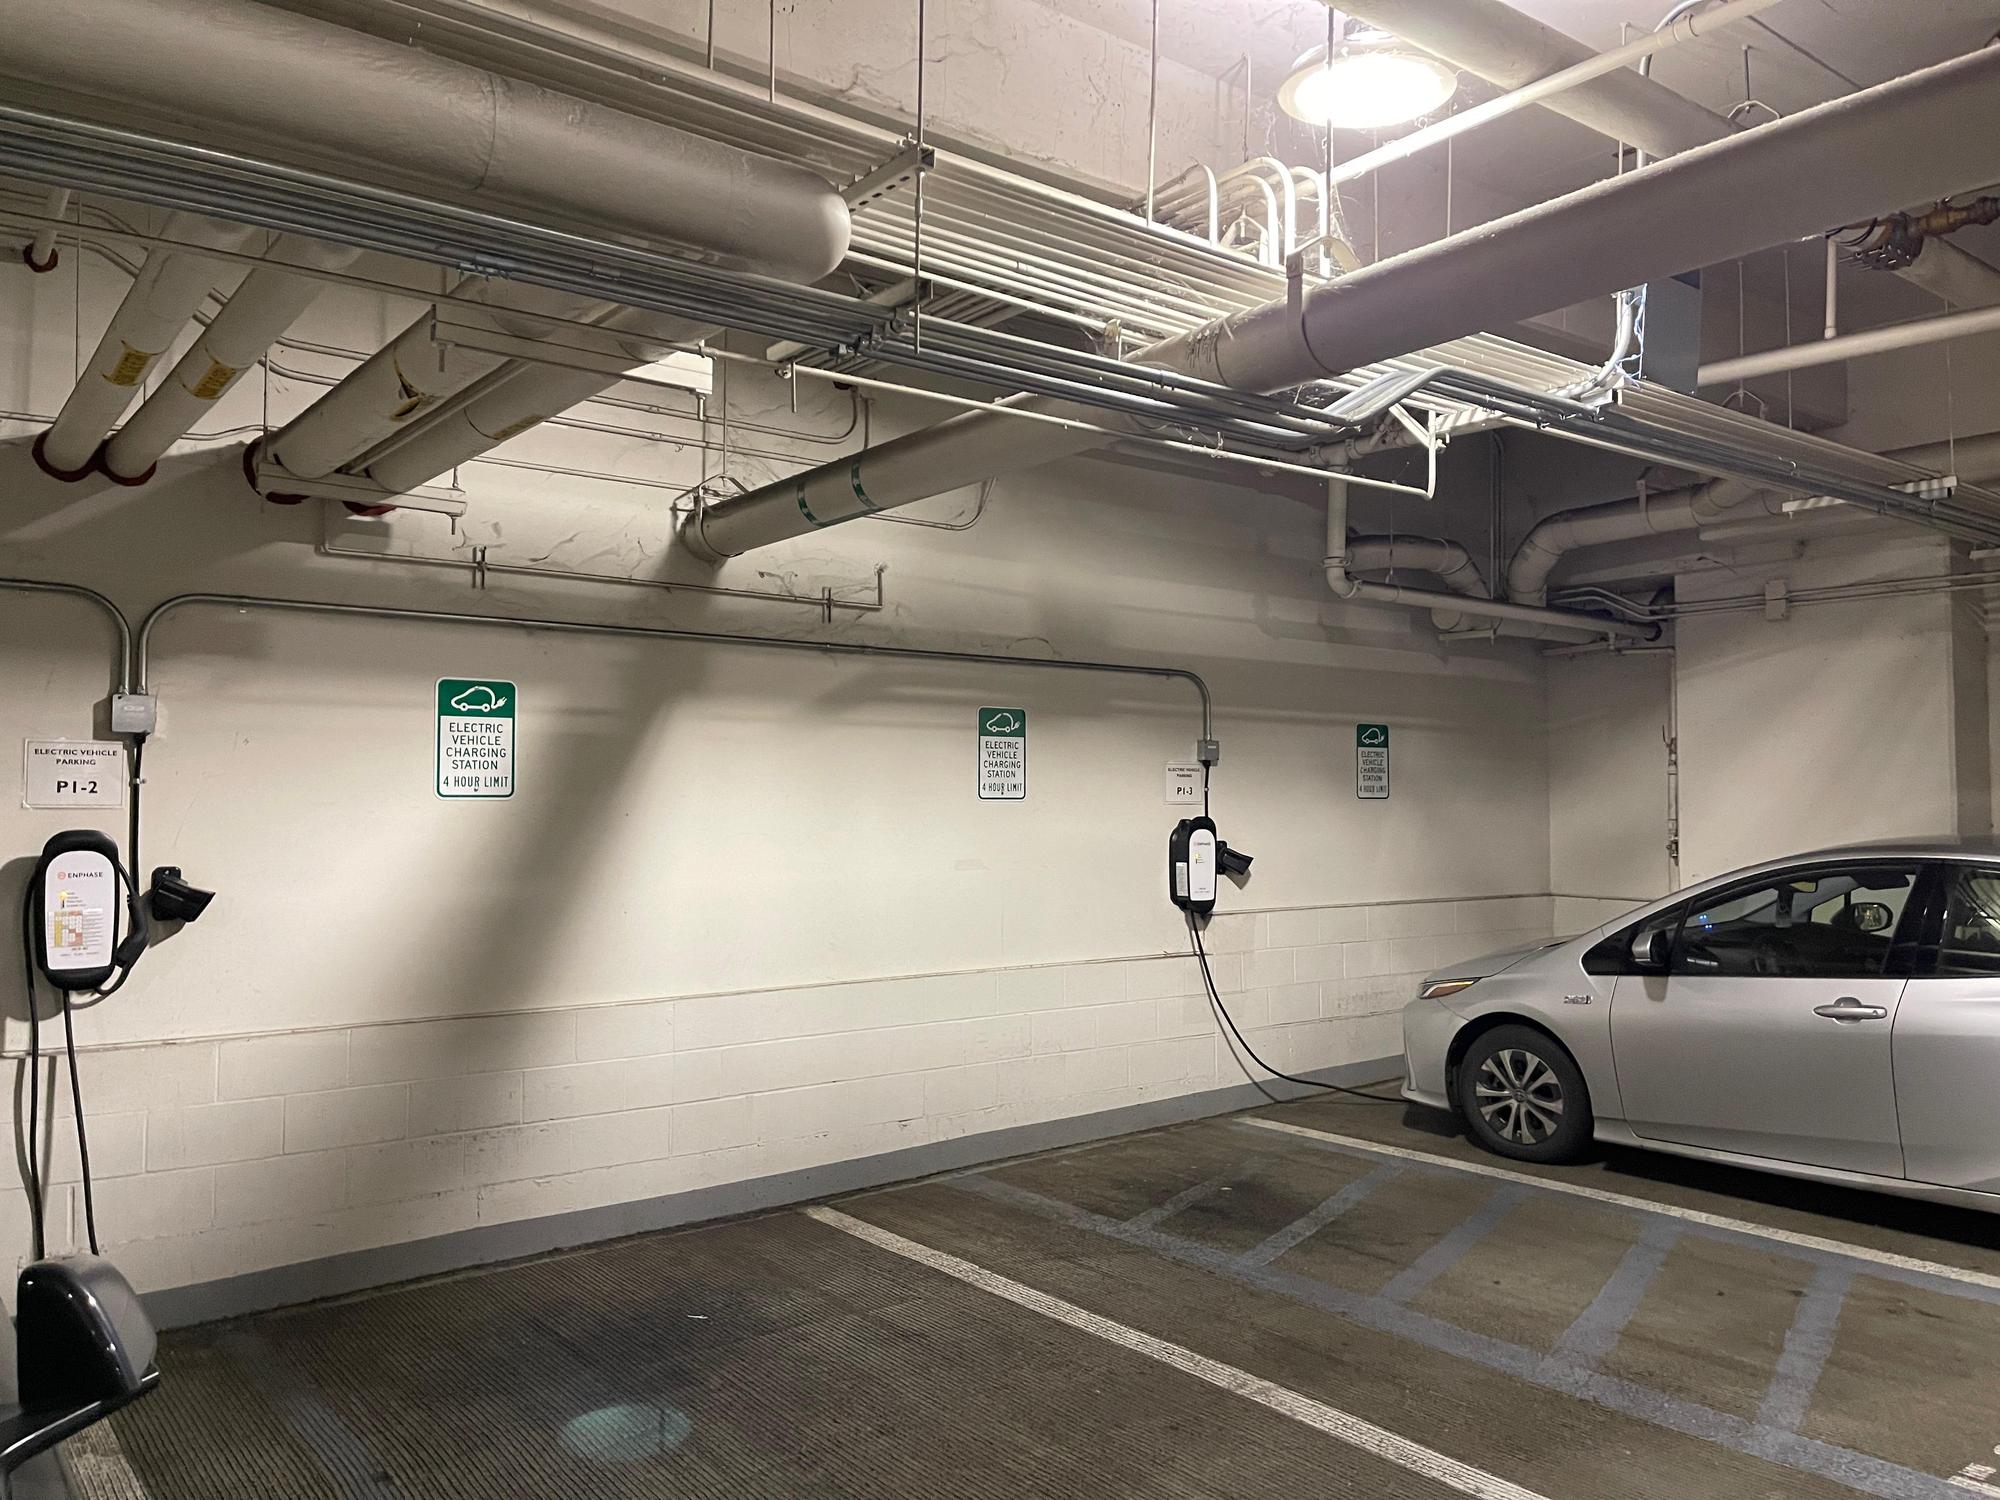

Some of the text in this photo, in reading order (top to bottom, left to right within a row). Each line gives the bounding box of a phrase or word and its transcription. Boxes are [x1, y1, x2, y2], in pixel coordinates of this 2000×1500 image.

[449, 722, 503, 733] ELECTRIC
[452, 735, 501, 745] VEHICLE
[985, 741, 1019, 749] ELECTRIC
[34, 748, 78, 756] ELECTRIC
[446, 747, 506, 758] CHARGING
[987, 751, 1017, 759] VEHICLE
[452, 760, 498, 770] STATION
[983, 760, 1021, 768] CHARGING
[443, 776, 508, 788] 4 HOUR LIMIT
[982, 783, 986, 791] 4
[1007, 783, 1022, 792] LIMIT
[67, 871, 104, 879] ENPHASE
